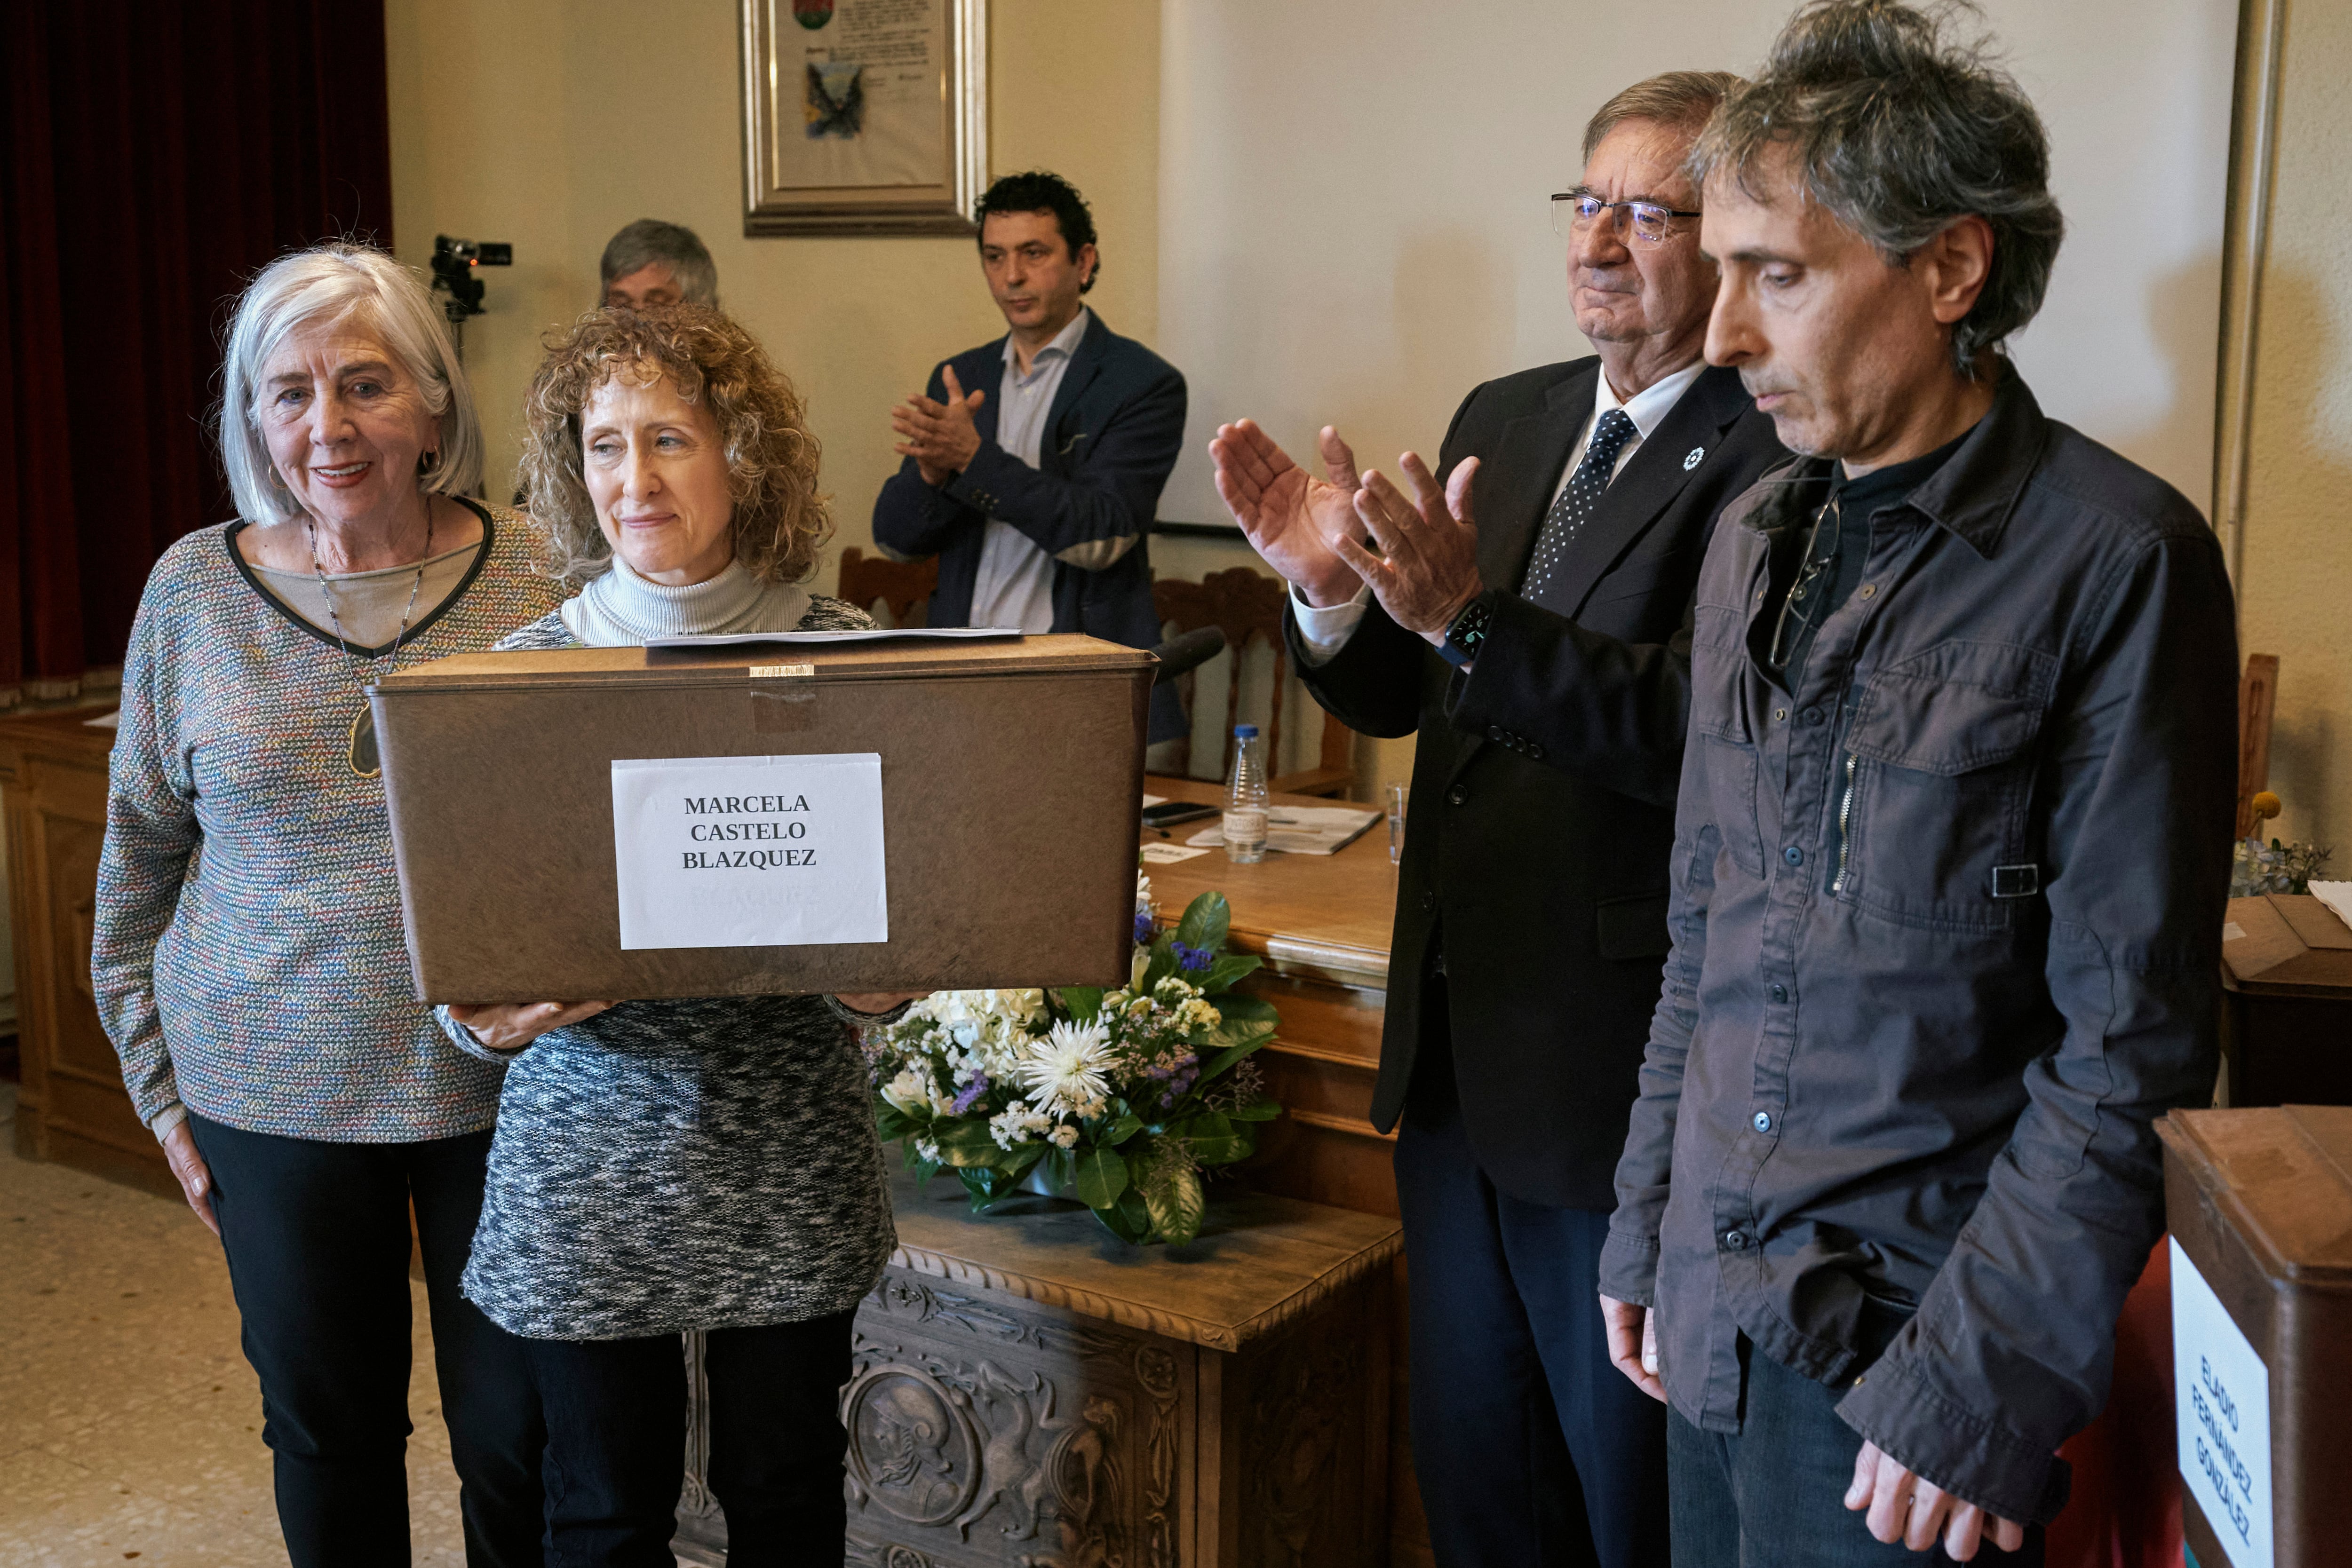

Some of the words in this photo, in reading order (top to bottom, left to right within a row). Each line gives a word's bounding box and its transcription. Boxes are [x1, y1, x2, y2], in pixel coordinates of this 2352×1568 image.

[683, 795, 810, 815] MARCELA
[691, 822, 806, 841] CASTELO
[682, 849, 817, 871] BLAZQUEZ
[2201, 1354, 2239, 1433] ELADIO
[2192, 1383, 2252, 1505] FERNÁNDEZ
[2196, 1436, 2250, 1548] GONZÁLEZ
